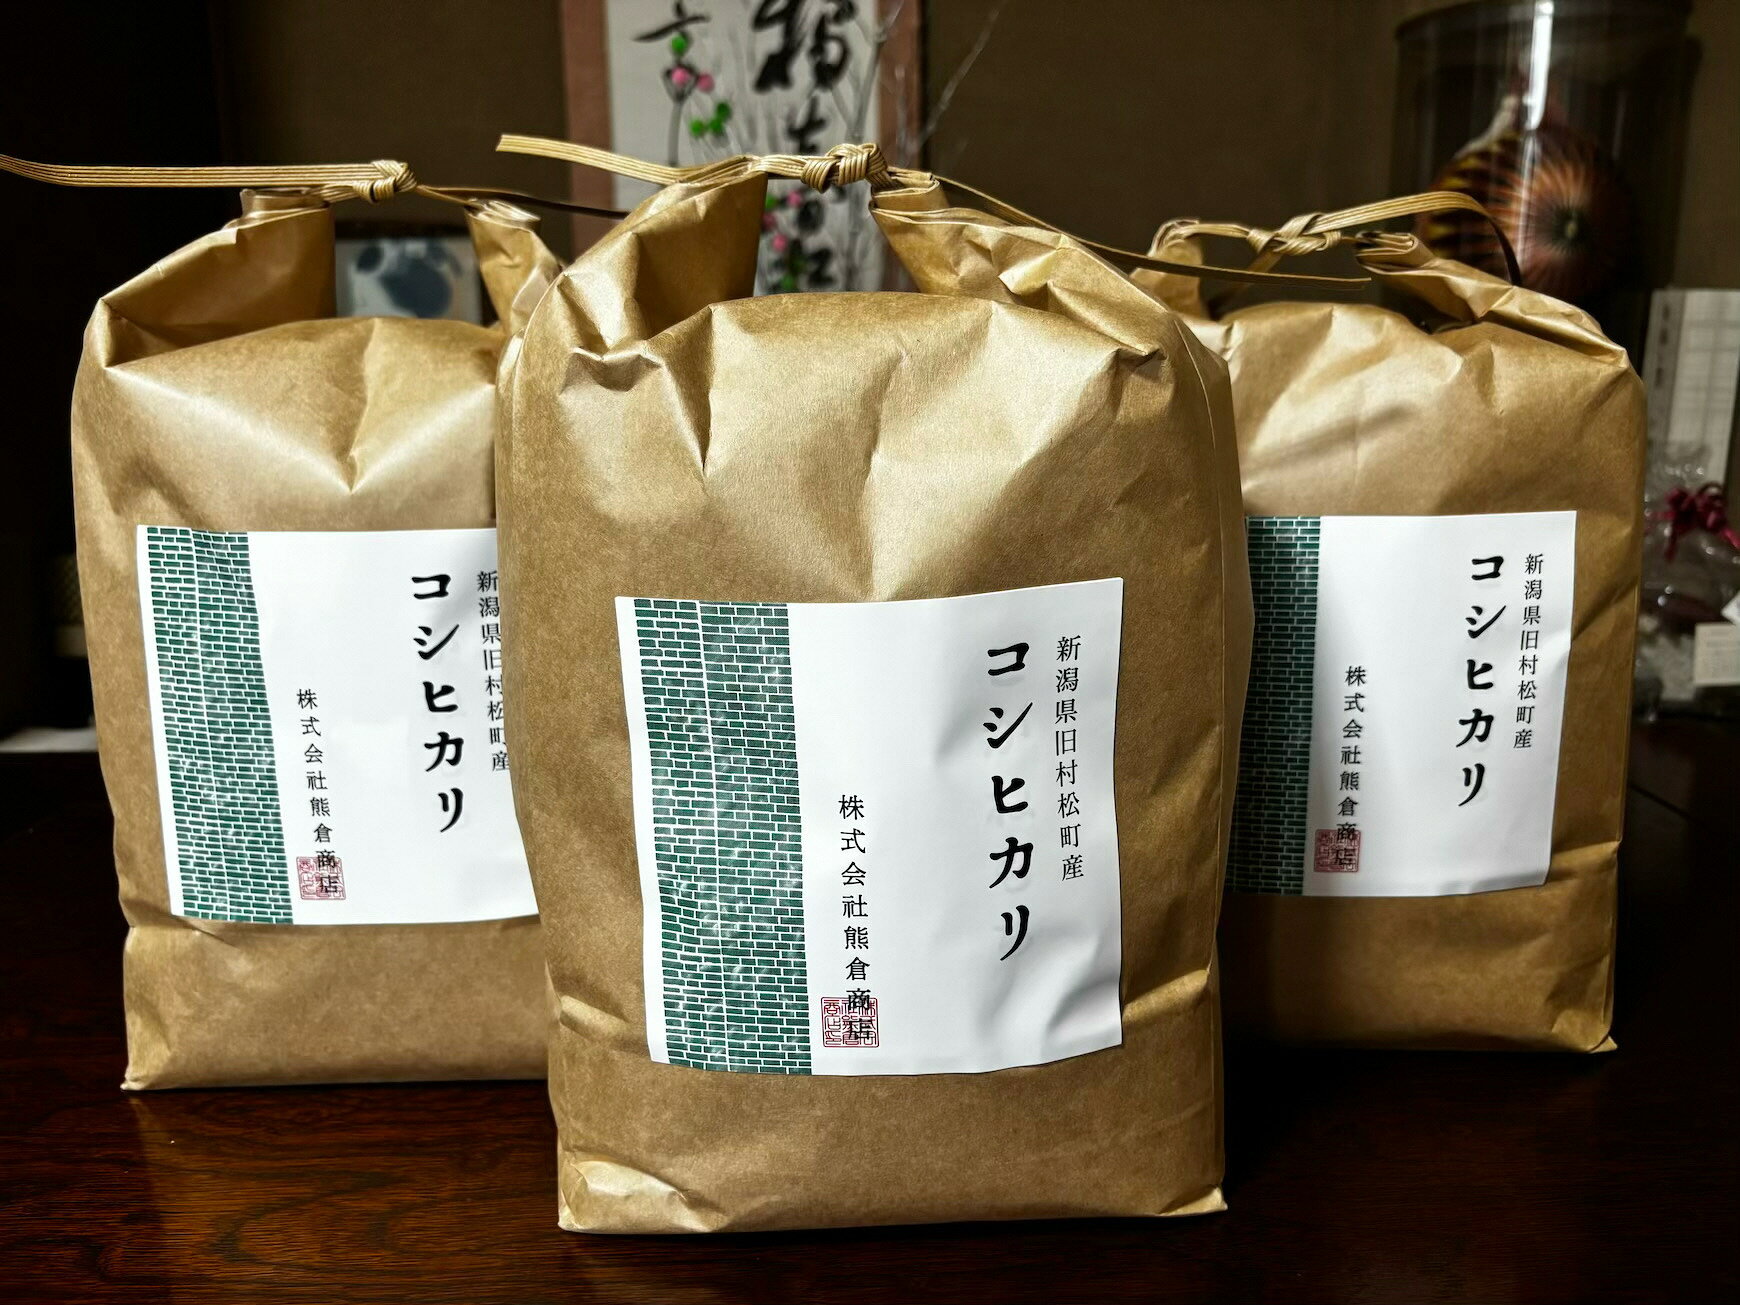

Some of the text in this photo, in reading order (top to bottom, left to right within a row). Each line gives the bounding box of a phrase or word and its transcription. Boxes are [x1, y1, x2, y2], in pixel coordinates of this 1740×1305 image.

[411, 573, 464, 833] コシヒカリ
[1055, 634, 1085, 881] 新潟県旧村松町産
[1334, 665, 1367, 866] 株式会社熊倉商店
[1455, 555, 1507, 807] コシヒカリ
[1513, 553, 1544, 750] 新潟県旧村松町産
[296, 688, 339, 894] 株式会社熊倉商店
[982, 642, 1034, 962] コシヒカリ
[838, 794, 872, 1040] 株式会社熊倉商店
